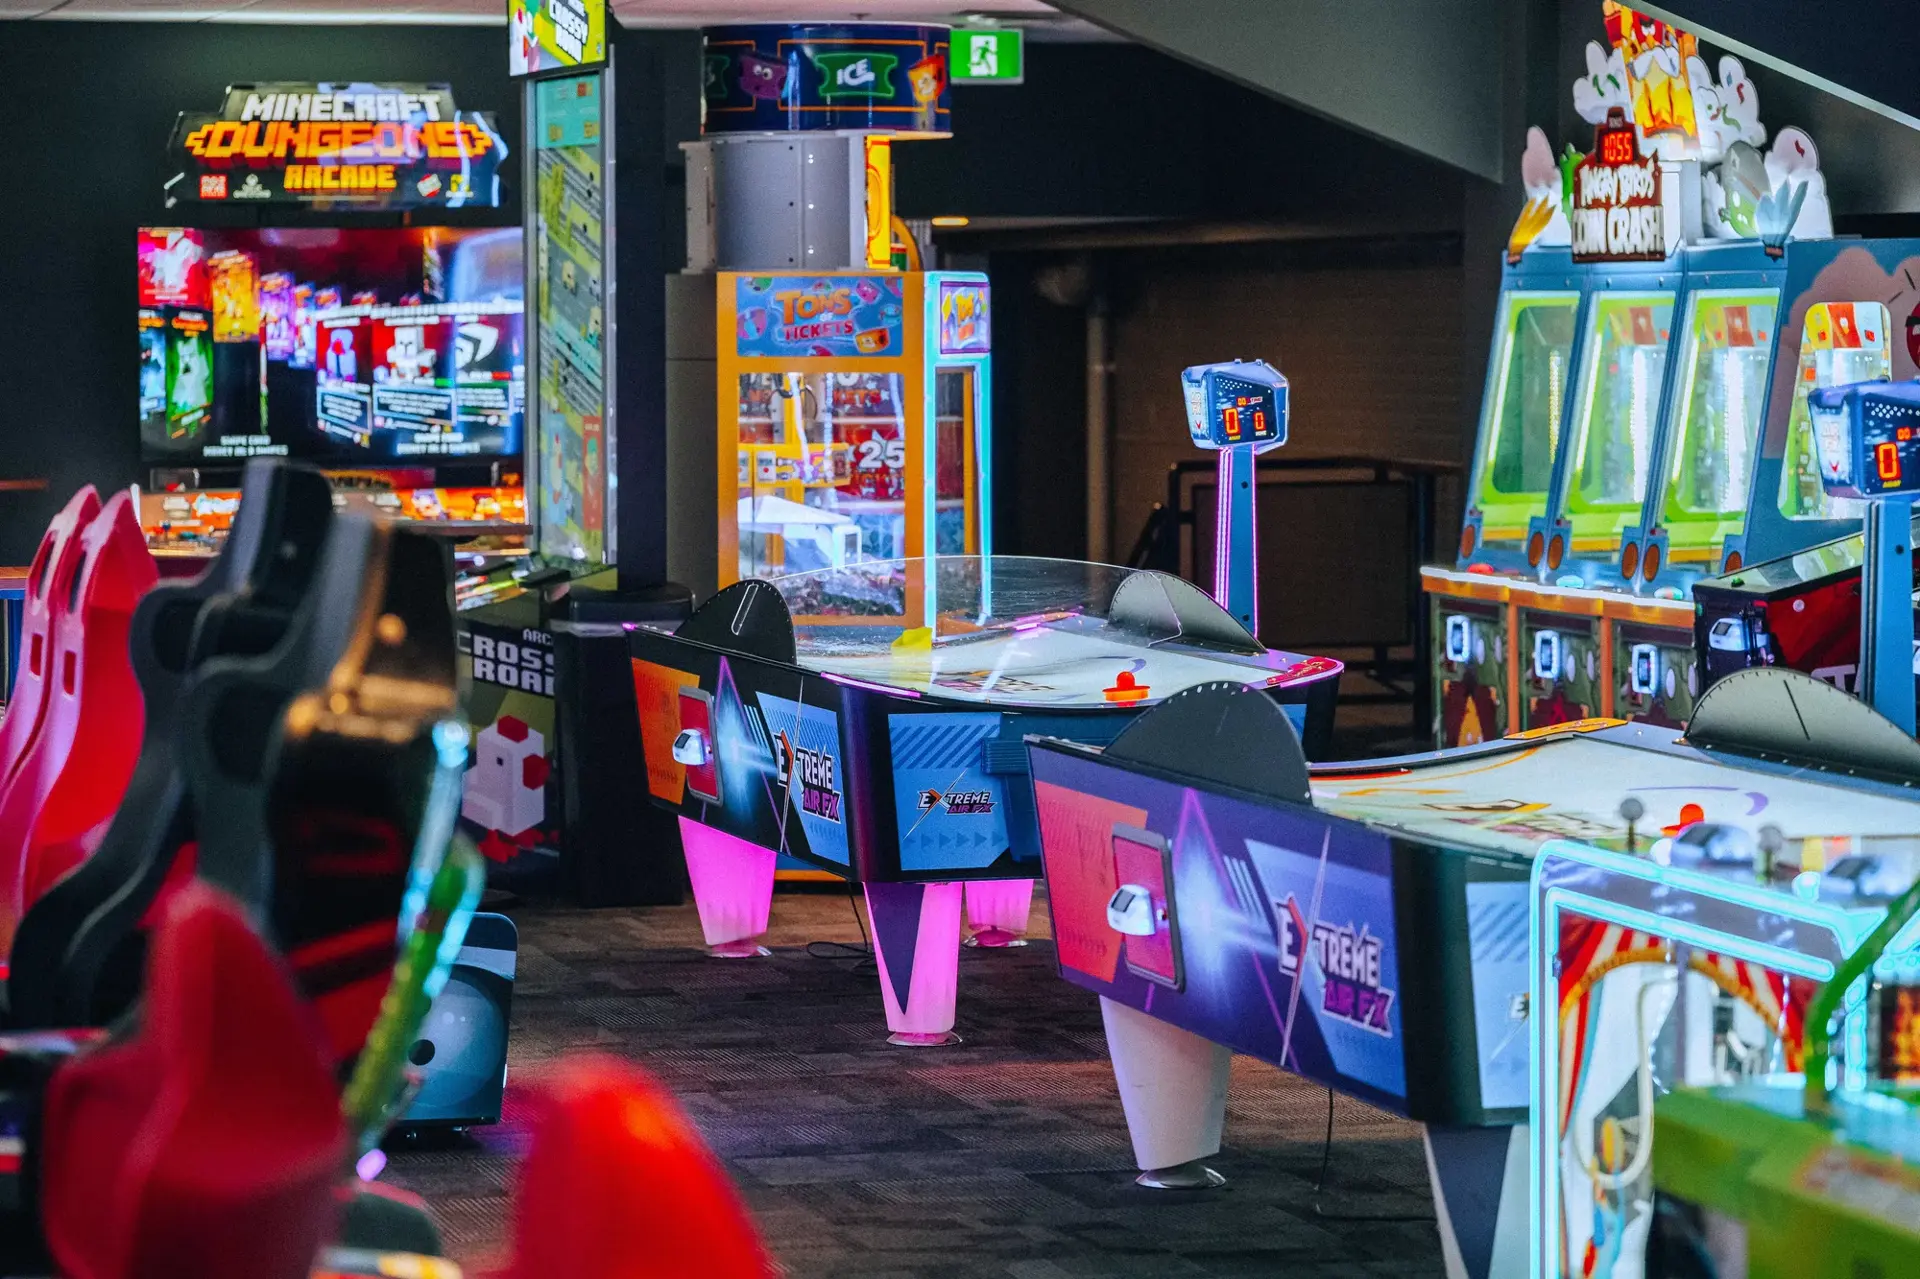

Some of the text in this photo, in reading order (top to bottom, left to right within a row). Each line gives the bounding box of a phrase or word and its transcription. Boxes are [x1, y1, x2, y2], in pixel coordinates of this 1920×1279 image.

[836, 58, 875, 86] ICE
[241, 93, 441, 122] MINECRAFT
[202, 120, 480, 164] DUNGEONS
[1603, 132, 1633, 161] 1055
[283, 164, 397, 191] ARCADE
[1579, 157, 1655, 207] ANGRY BIRDS
[1573, 206, 1607, 255] COIN
[775, 288, 852, 324] TONS
[783, 320, 854, 341] TICKETS
[1225, 408, 1264, 434] 0 0
[1877, 443, 1898, 479] 0
[773, 731, 833, 790] EXTREME
[803, 786, 840, 819] AIR FX
[918, 788, 990, 809] EXTREME
[947, 803, 994, 814] AIR FX
[1275, 895, 1379, 988] EXTREME
